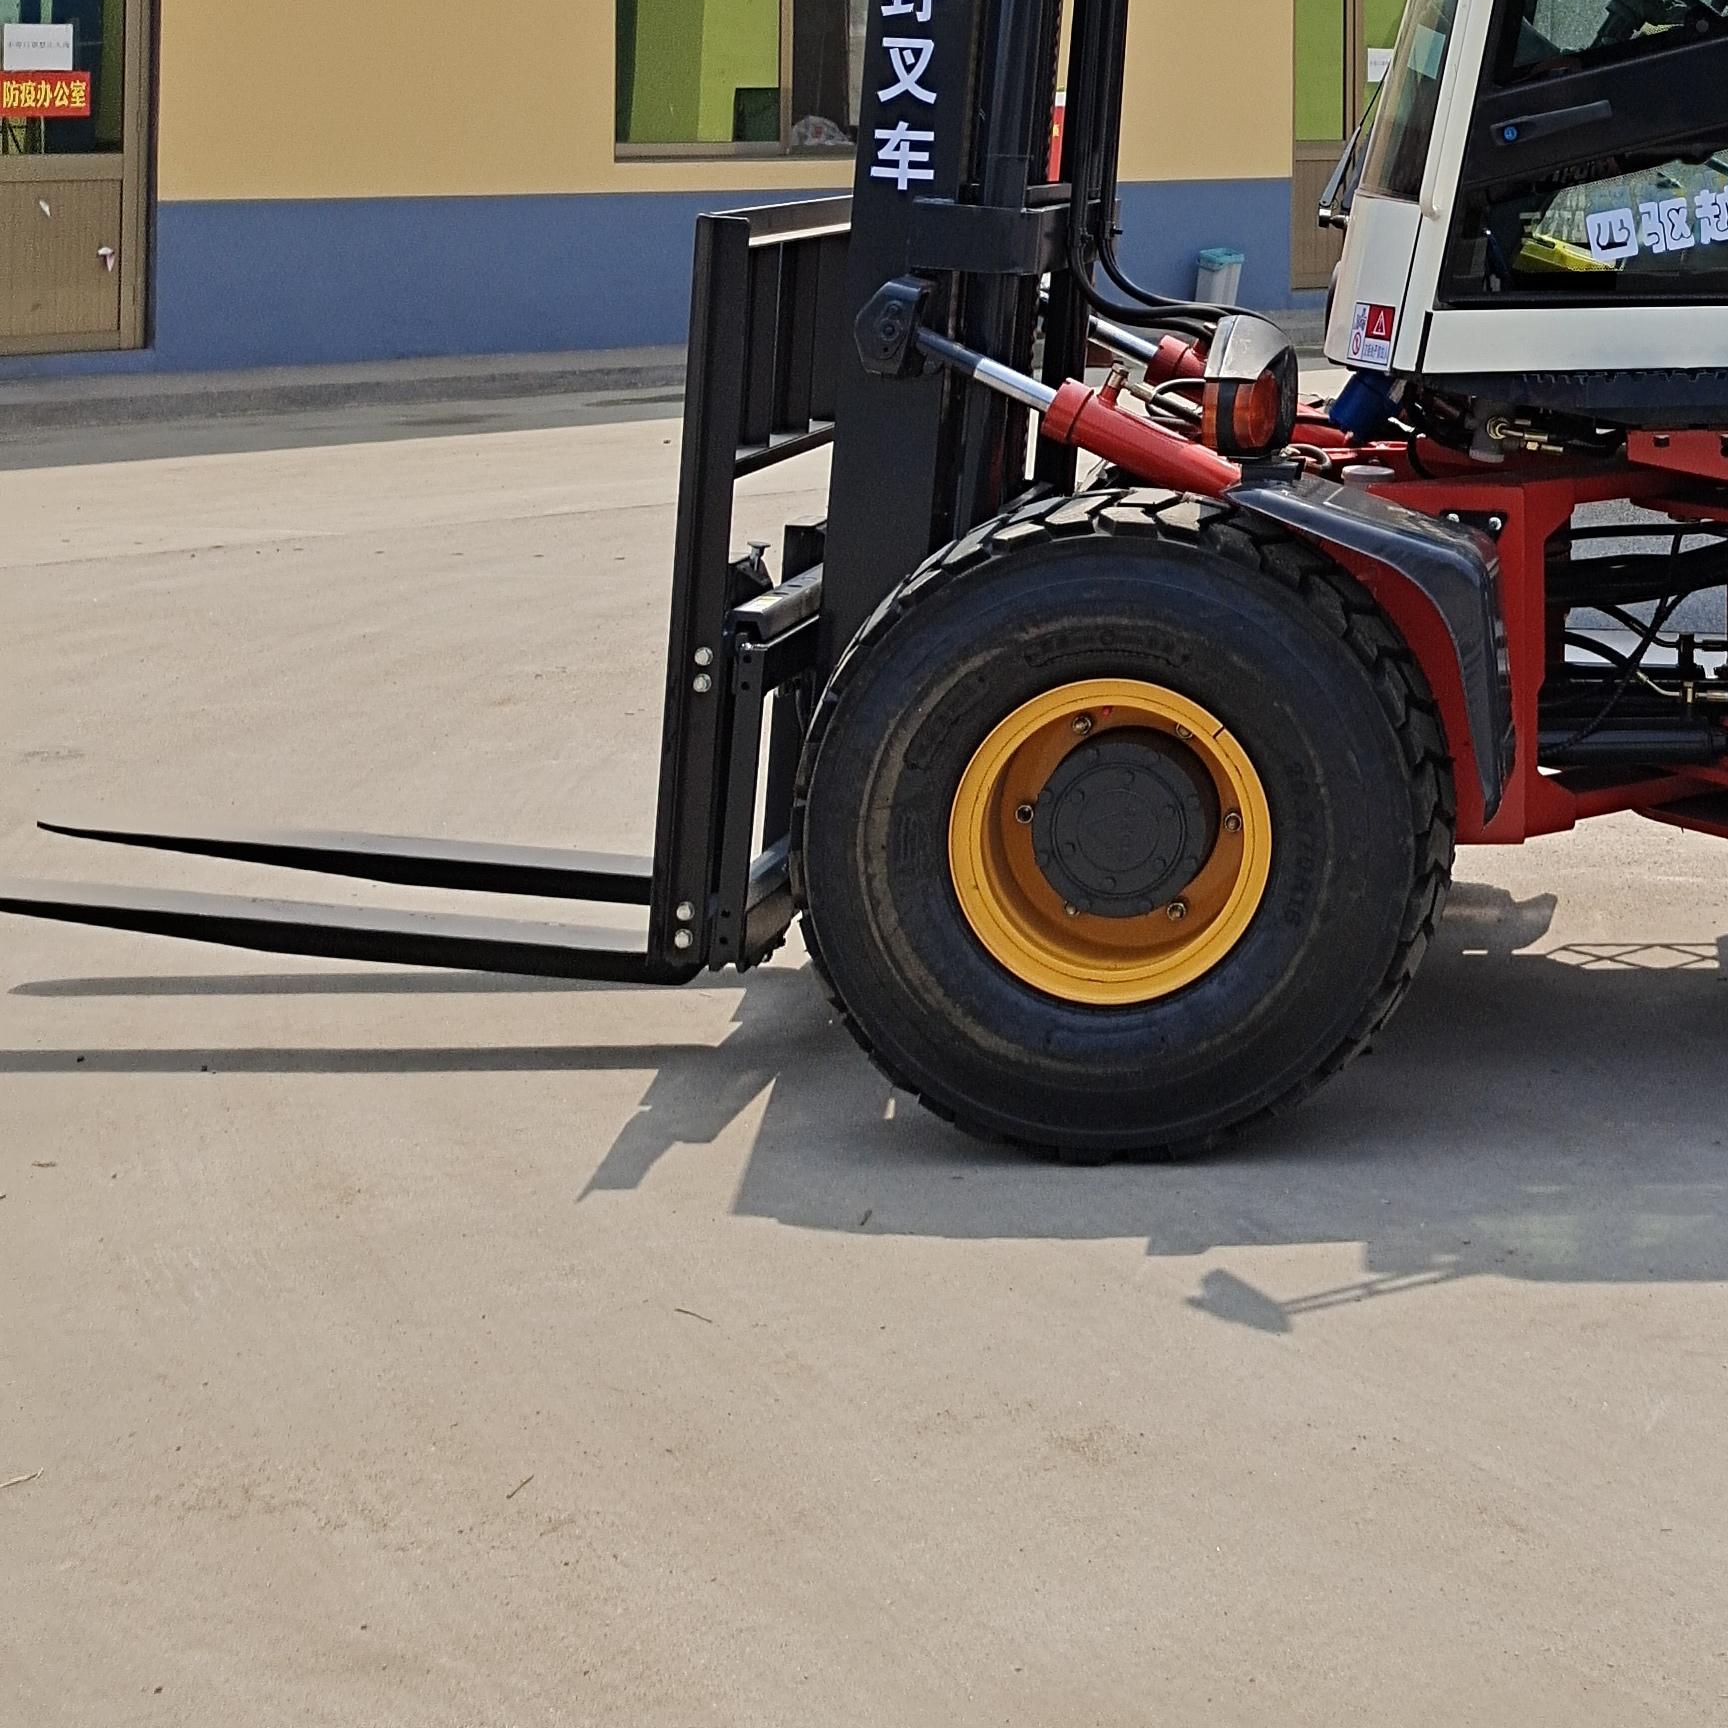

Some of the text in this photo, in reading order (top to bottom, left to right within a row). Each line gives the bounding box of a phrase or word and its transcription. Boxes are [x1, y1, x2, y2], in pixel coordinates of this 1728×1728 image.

[3, 79, 87, 109] 防疫办公室
